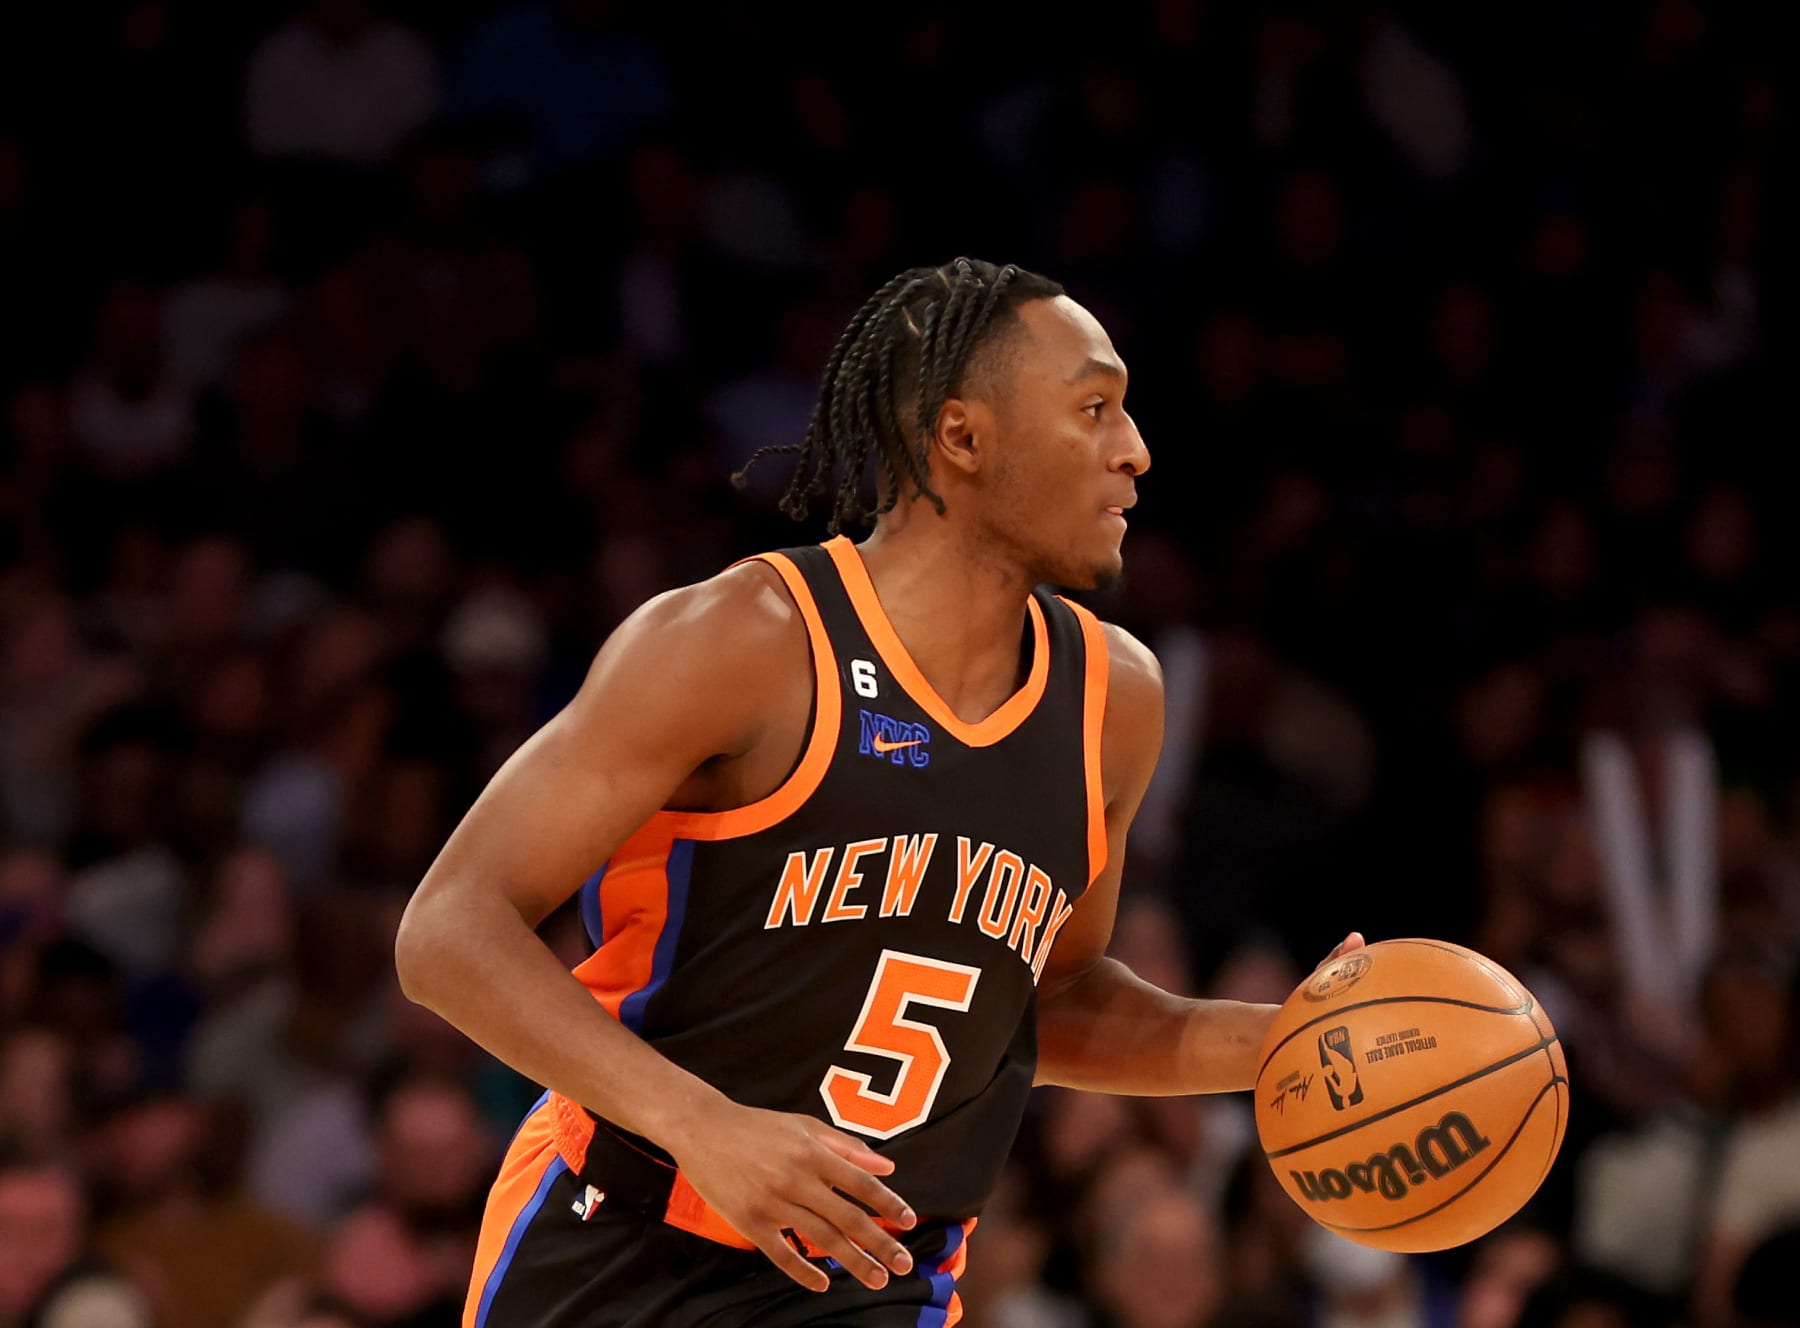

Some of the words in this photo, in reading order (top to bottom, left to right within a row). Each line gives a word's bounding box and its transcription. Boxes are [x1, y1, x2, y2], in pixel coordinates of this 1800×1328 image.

[851, 659, 878, 698] 6
[859, 709, 930, 767] NYC
[763, 833, 939, 929] NEW
[948, 836, 1073, 986] YORK
[819, 949, 982, 1141] 5
[1366, 1048, 1383, 1064] BALL
[1404, 1036, 1437, 1054] OFFICIAL
[1290, 1111, 1491, 1201] Wilson
